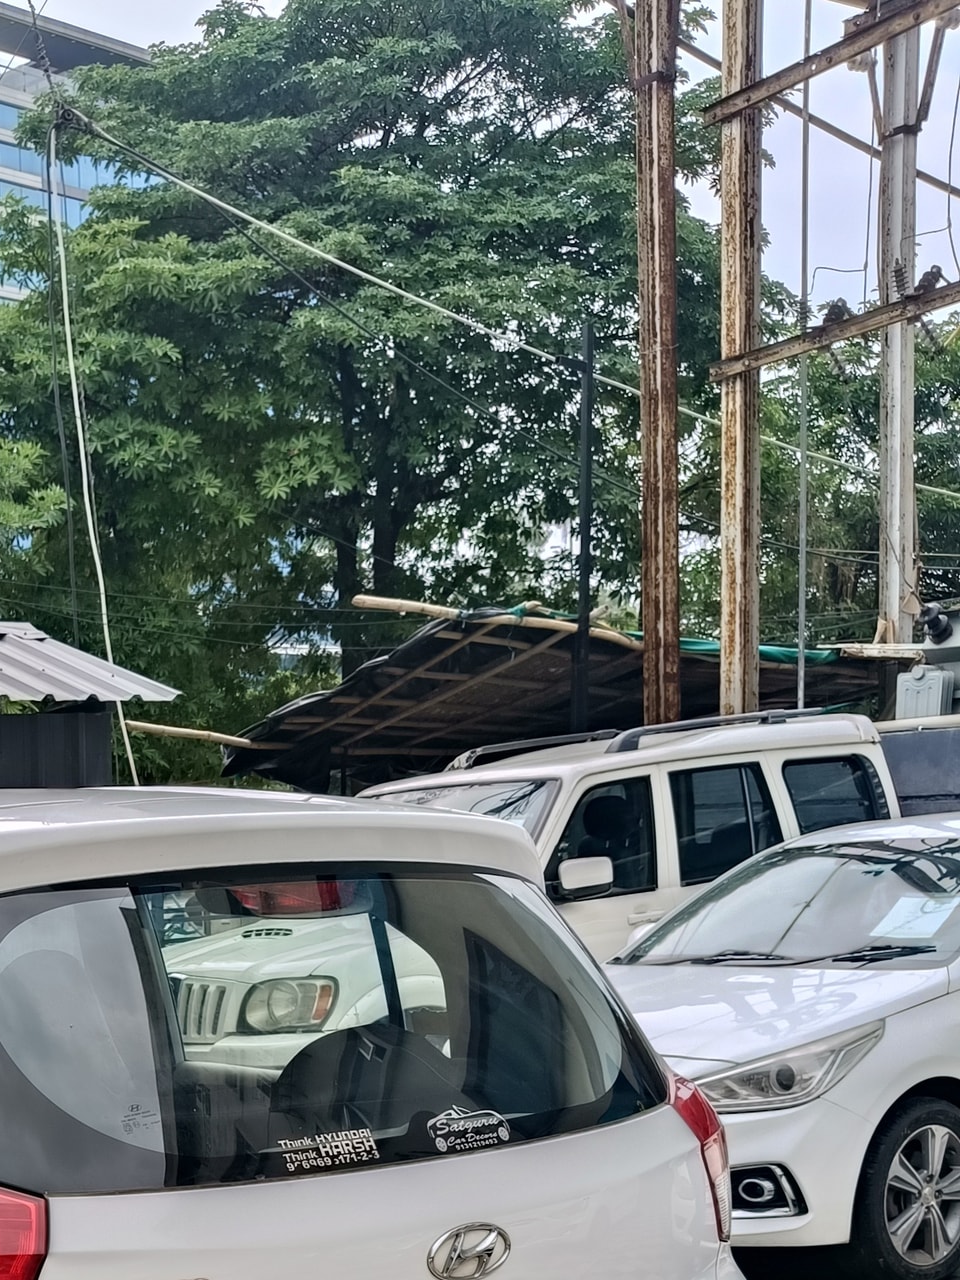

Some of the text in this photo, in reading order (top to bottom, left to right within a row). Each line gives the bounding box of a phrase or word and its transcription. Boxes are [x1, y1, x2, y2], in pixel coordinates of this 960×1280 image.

[435, 1117, 499, 1134] Satguru
[278, 1128, 372, 1149] Think HYUNDAI
[447, 1136, 466, 1146] Car
[282, 1137, 377, 1162] Think HARSH
